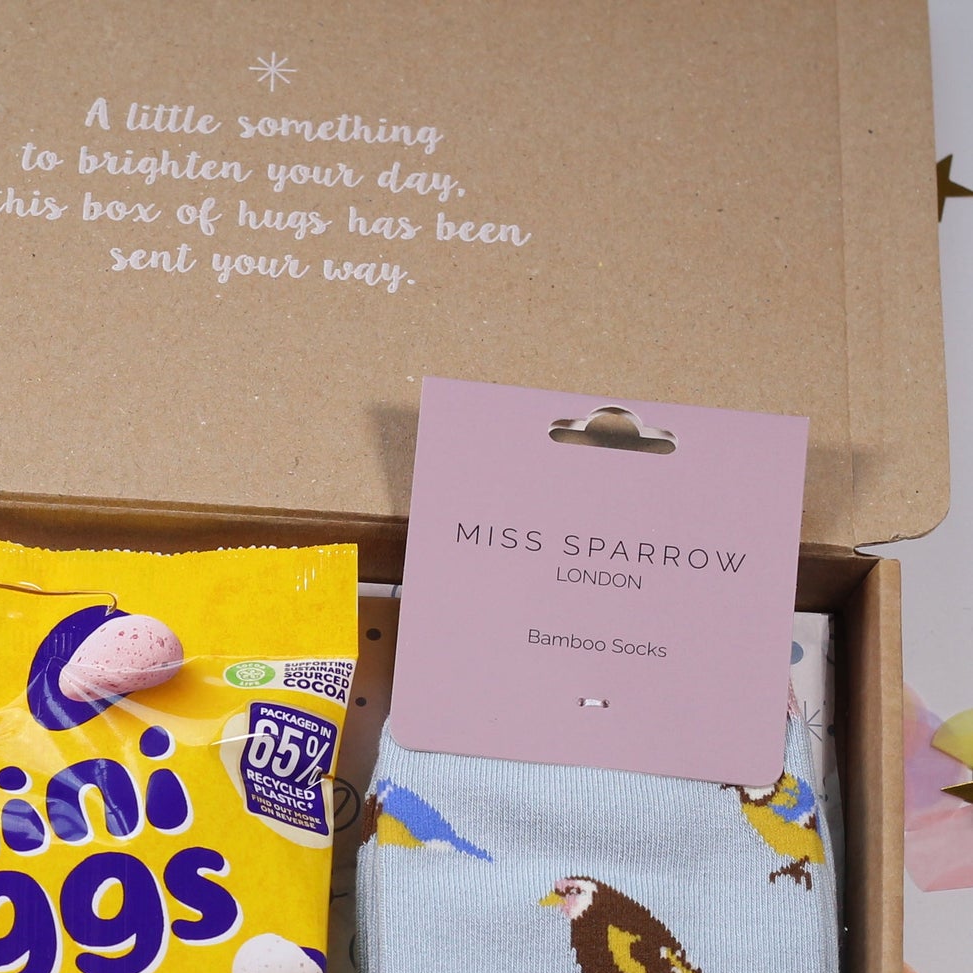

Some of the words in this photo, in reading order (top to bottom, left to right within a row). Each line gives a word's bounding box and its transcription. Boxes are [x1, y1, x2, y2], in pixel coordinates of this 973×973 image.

[84, 97, 110, 130] A
[126, 102, 222, 135] little
[237, 112, 443, 154] something
[22, 142, 63, 172] to
[78, 146, 252, 185] brighten
[267, 161, 364, 192] your
[378, 162, 466, 201] day,
[82, 190, 161, 223] box
[177, 197, 222, 235] of
[238, 200, 332, 239] hugs
[348, 206, 422, 239] has
[436, 213, 532, 246] been
[110, 242, 197, 272] sent
[212, 252, 310, 283] your
[323, 258, 416, 293] way.
[456, 522, 543, 552] MISS
[563, 534, 747, 573] SPARROW
[556, 566, 643, 590] LONDON
[528, 628, 607, 652] Bamboo
[612, 638, 668, 658] Socks
[284, 660, 353, 670] SUPPORTING
[284, 666, 352, 678] SUSTAINABLY
[284, 672, 350, 689] SOURCED
[283, 678, 346, 703] COCOA
[260, 707, 319, 733] PACKAGED
[320, 725, 332, 739] IN
[248, 719, 330, 785] 65%
[246, 768, 316, 800] RECYCLED
[251, 794, 272, 807] FIND
[274, 803, 292, 816] OUT
[294, 811, 322, 824] MORE
[260, 805, 275, 815] ON
[275, 811, 317, 829] REVERSE
